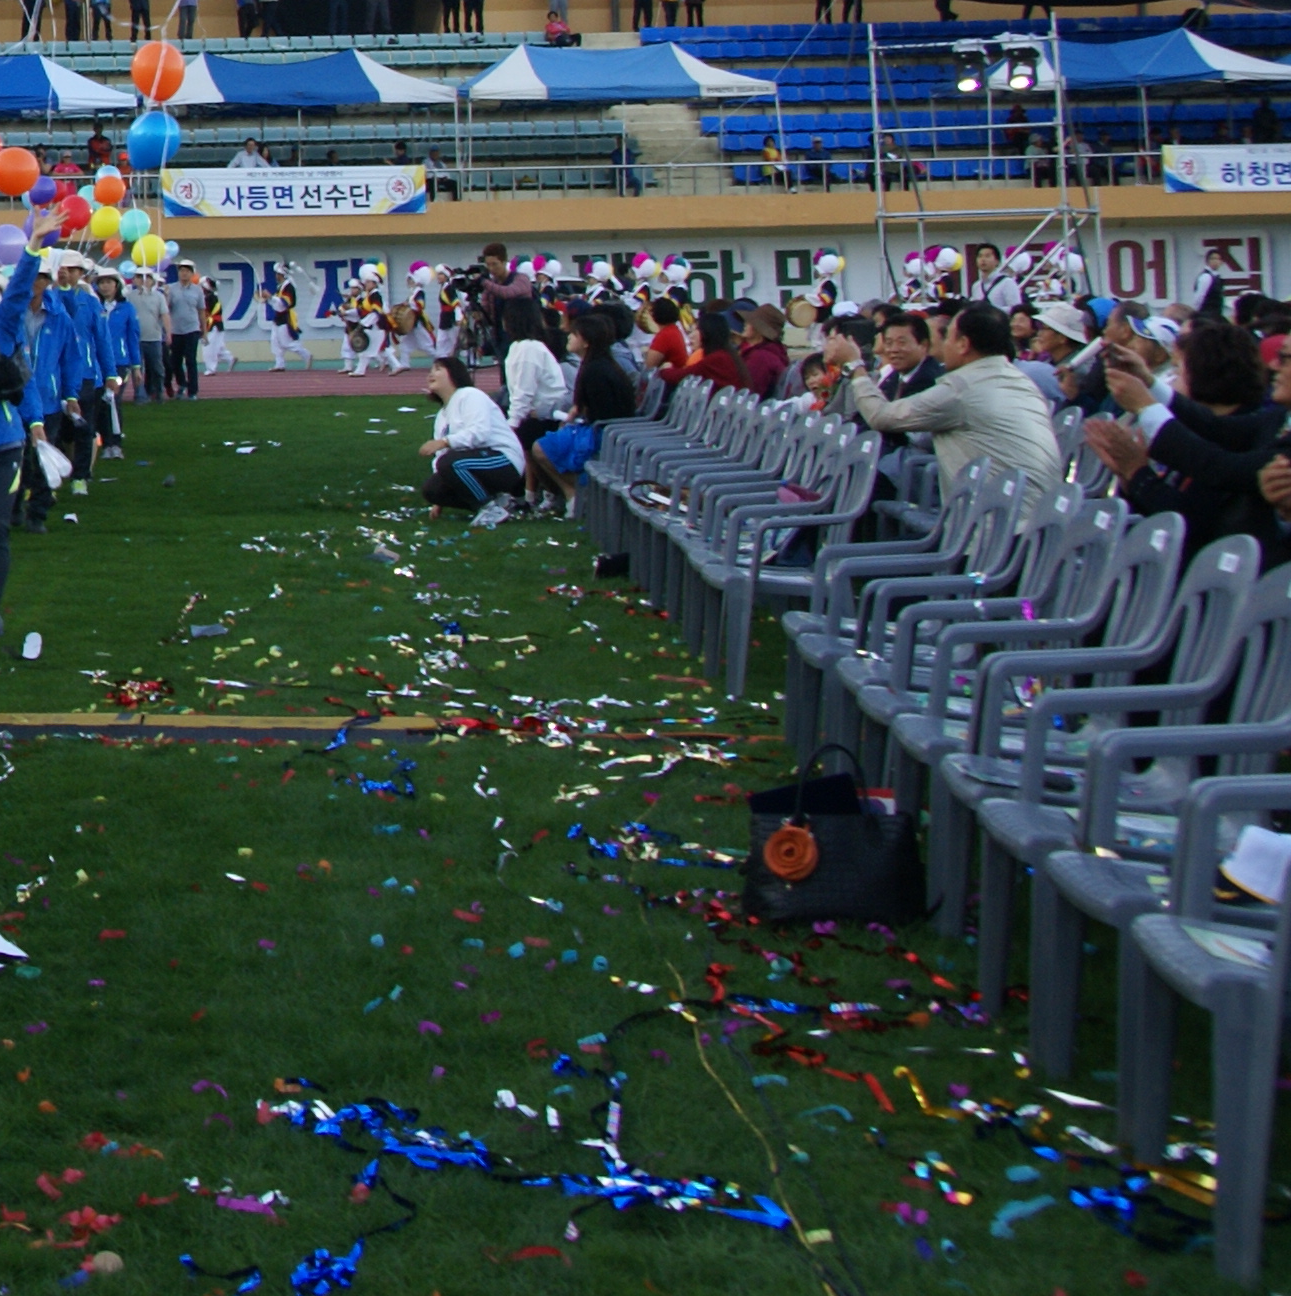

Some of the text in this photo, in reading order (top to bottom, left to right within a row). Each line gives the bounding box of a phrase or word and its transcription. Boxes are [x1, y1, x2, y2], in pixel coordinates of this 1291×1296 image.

[179, 182, 194, 201] 경
[221, 183, 374, 211] 사등면 선수단
